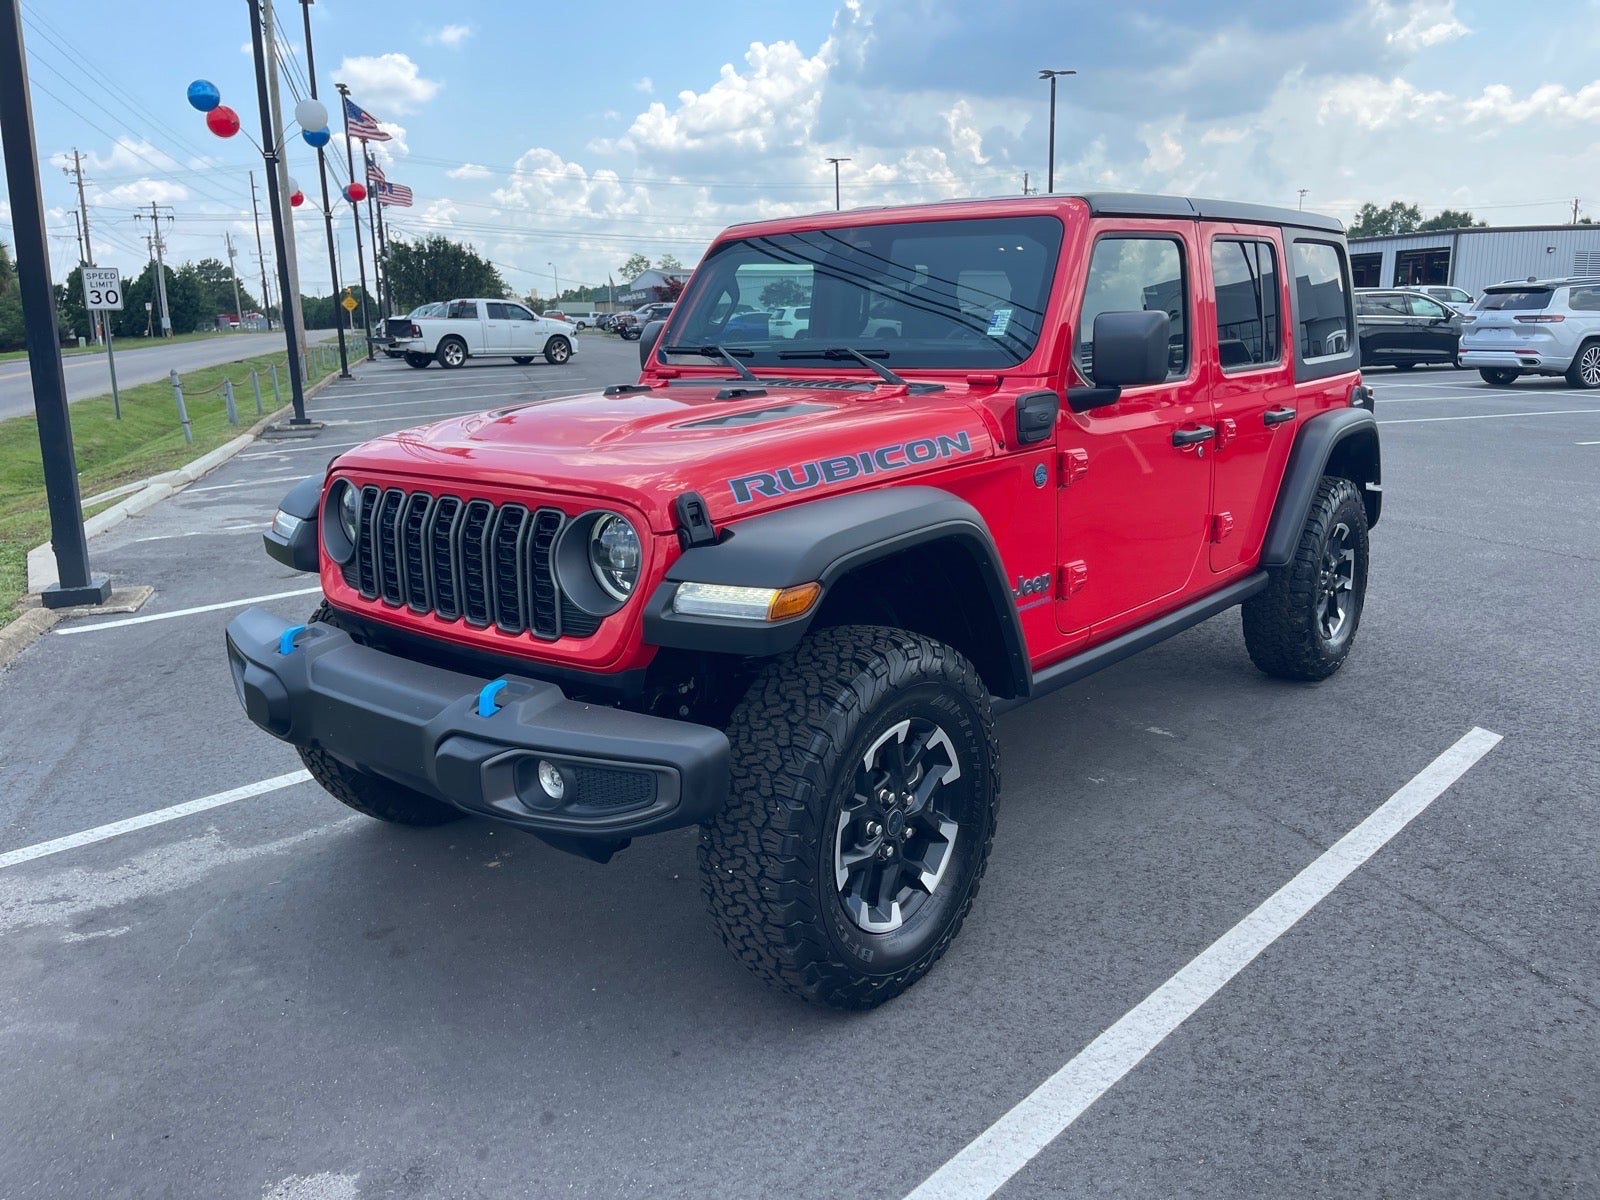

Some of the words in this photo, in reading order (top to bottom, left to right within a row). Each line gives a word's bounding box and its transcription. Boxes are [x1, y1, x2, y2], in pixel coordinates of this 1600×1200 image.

[86, 272, 116, 280] SPEED
[90, 290, 118, 304] 30
[728, 431, 972, 504] RUBICON
[1012, 572, 1052, 600] Jeep
